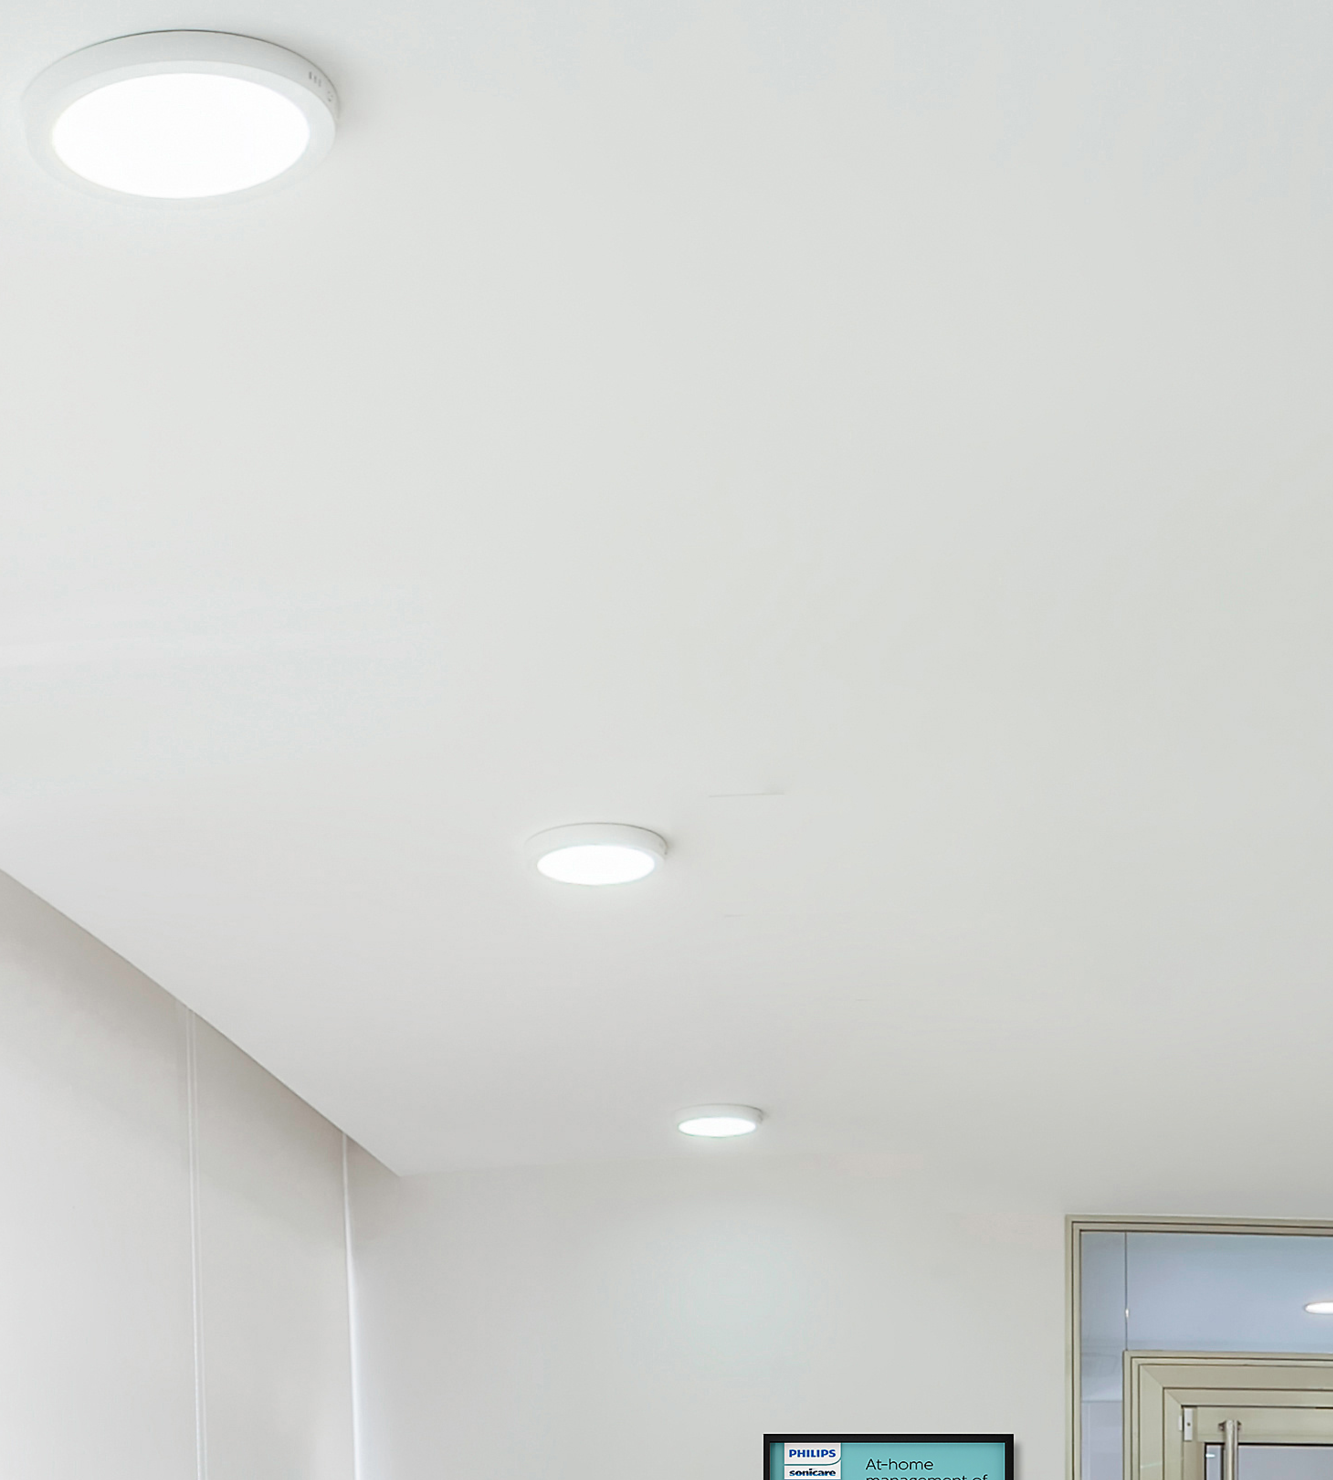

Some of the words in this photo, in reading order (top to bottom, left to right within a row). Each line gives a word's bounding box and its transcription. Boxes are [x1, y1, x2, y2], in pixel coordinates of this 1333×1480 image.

[789, 1449, 836, 1458] PHILIPS
[865, 1458, 934, 1470] At-home
[789, 1468, 836, 1477] sonicare
